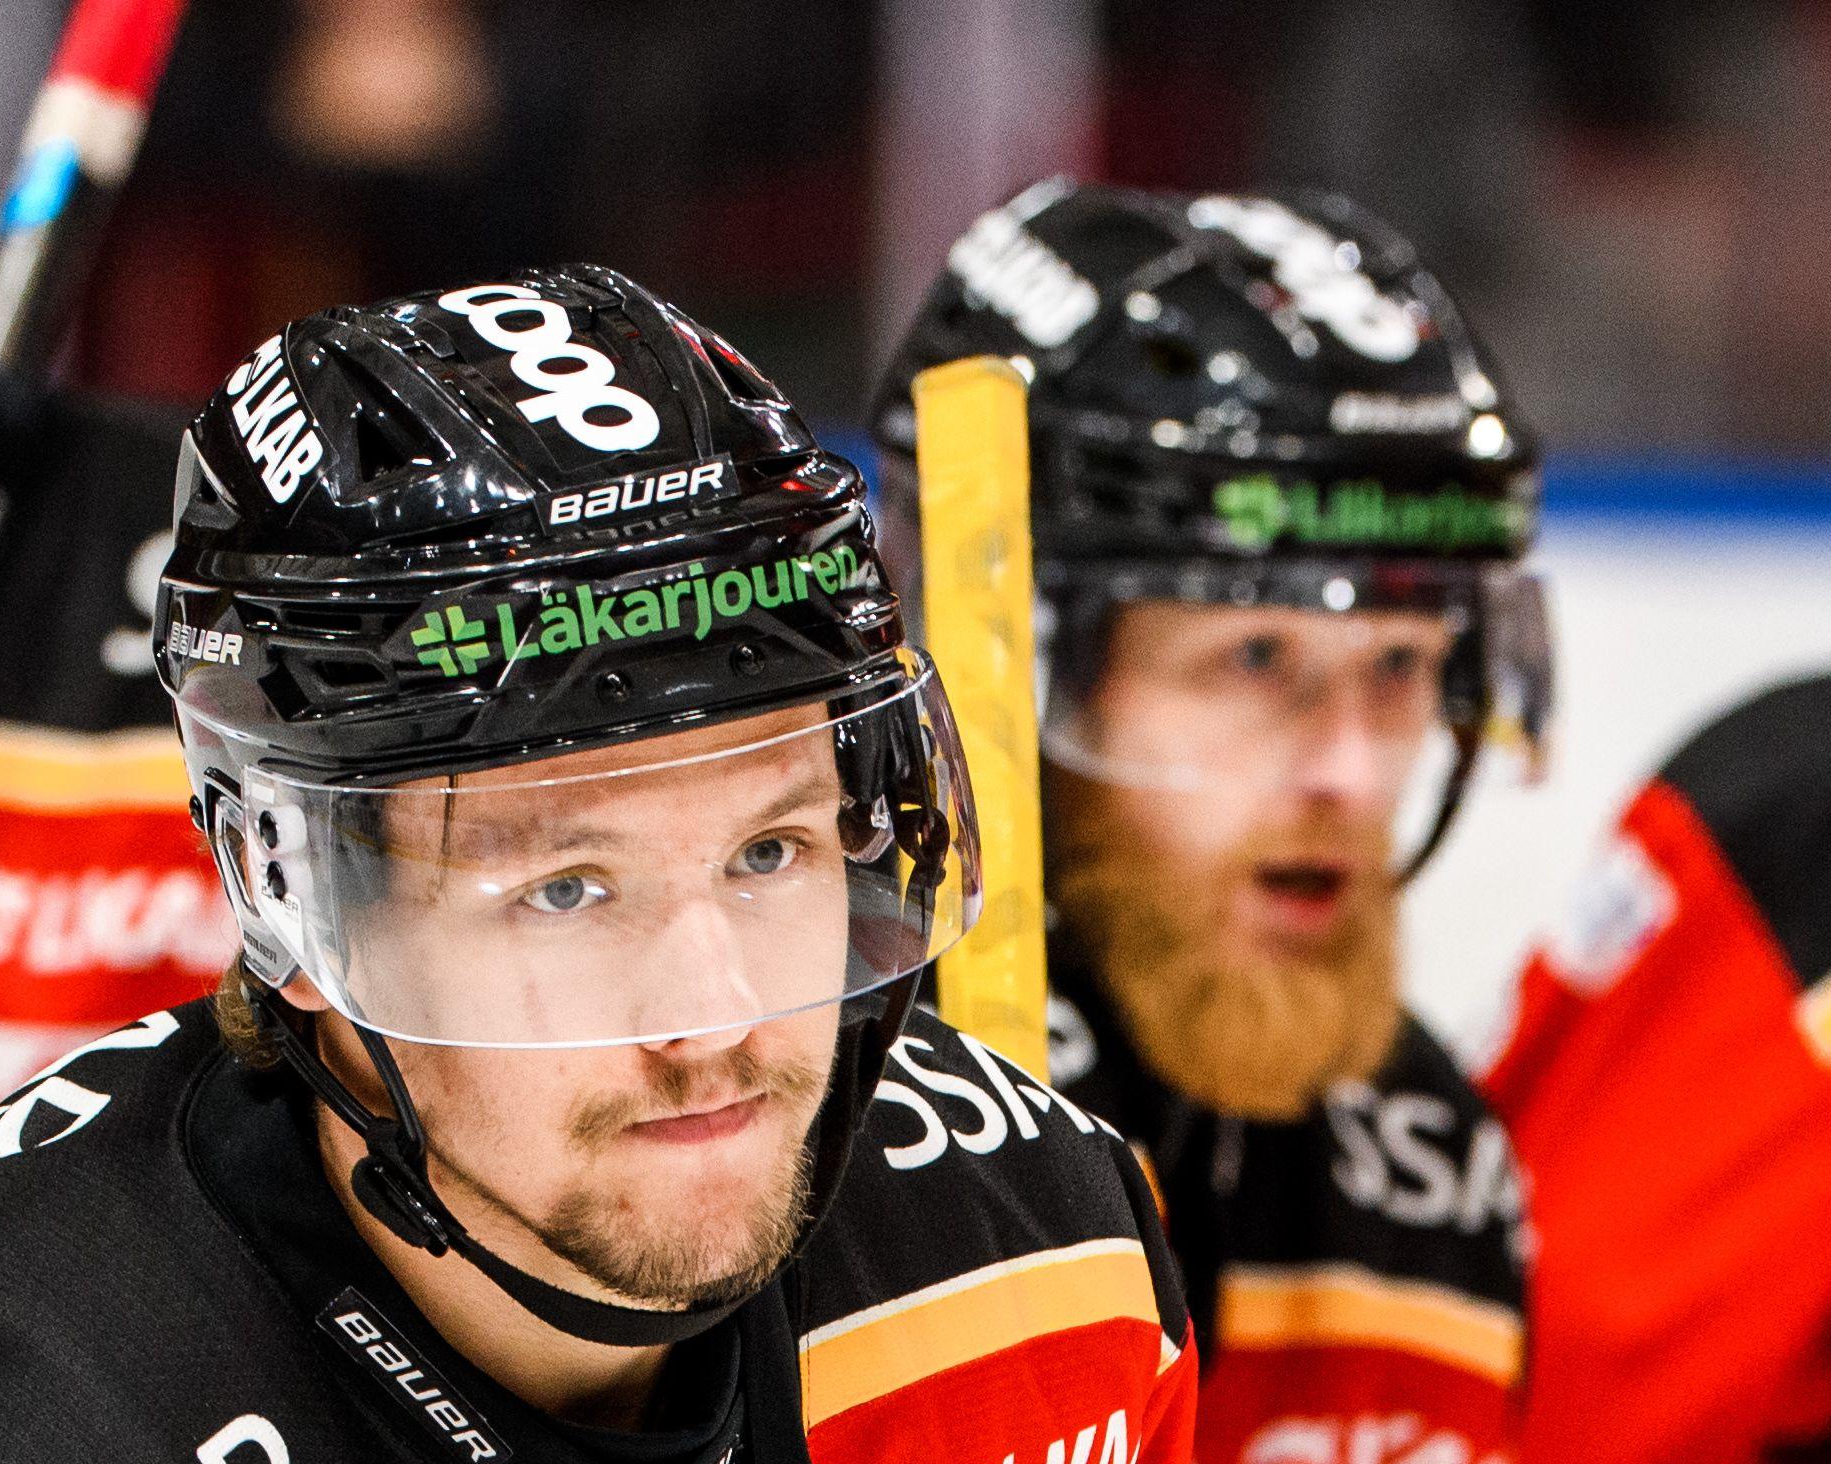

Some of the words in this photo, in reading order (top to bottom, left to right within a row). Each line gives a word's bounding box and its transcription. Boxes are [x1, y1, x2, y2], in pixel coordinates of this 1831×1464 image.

[231, 358, 323, 504] LKAB
[438, 284, 661, 452] coop
[499, 543, 860, 664] Läkarjouren
[873, 1031, 1125, 1170] SSA
